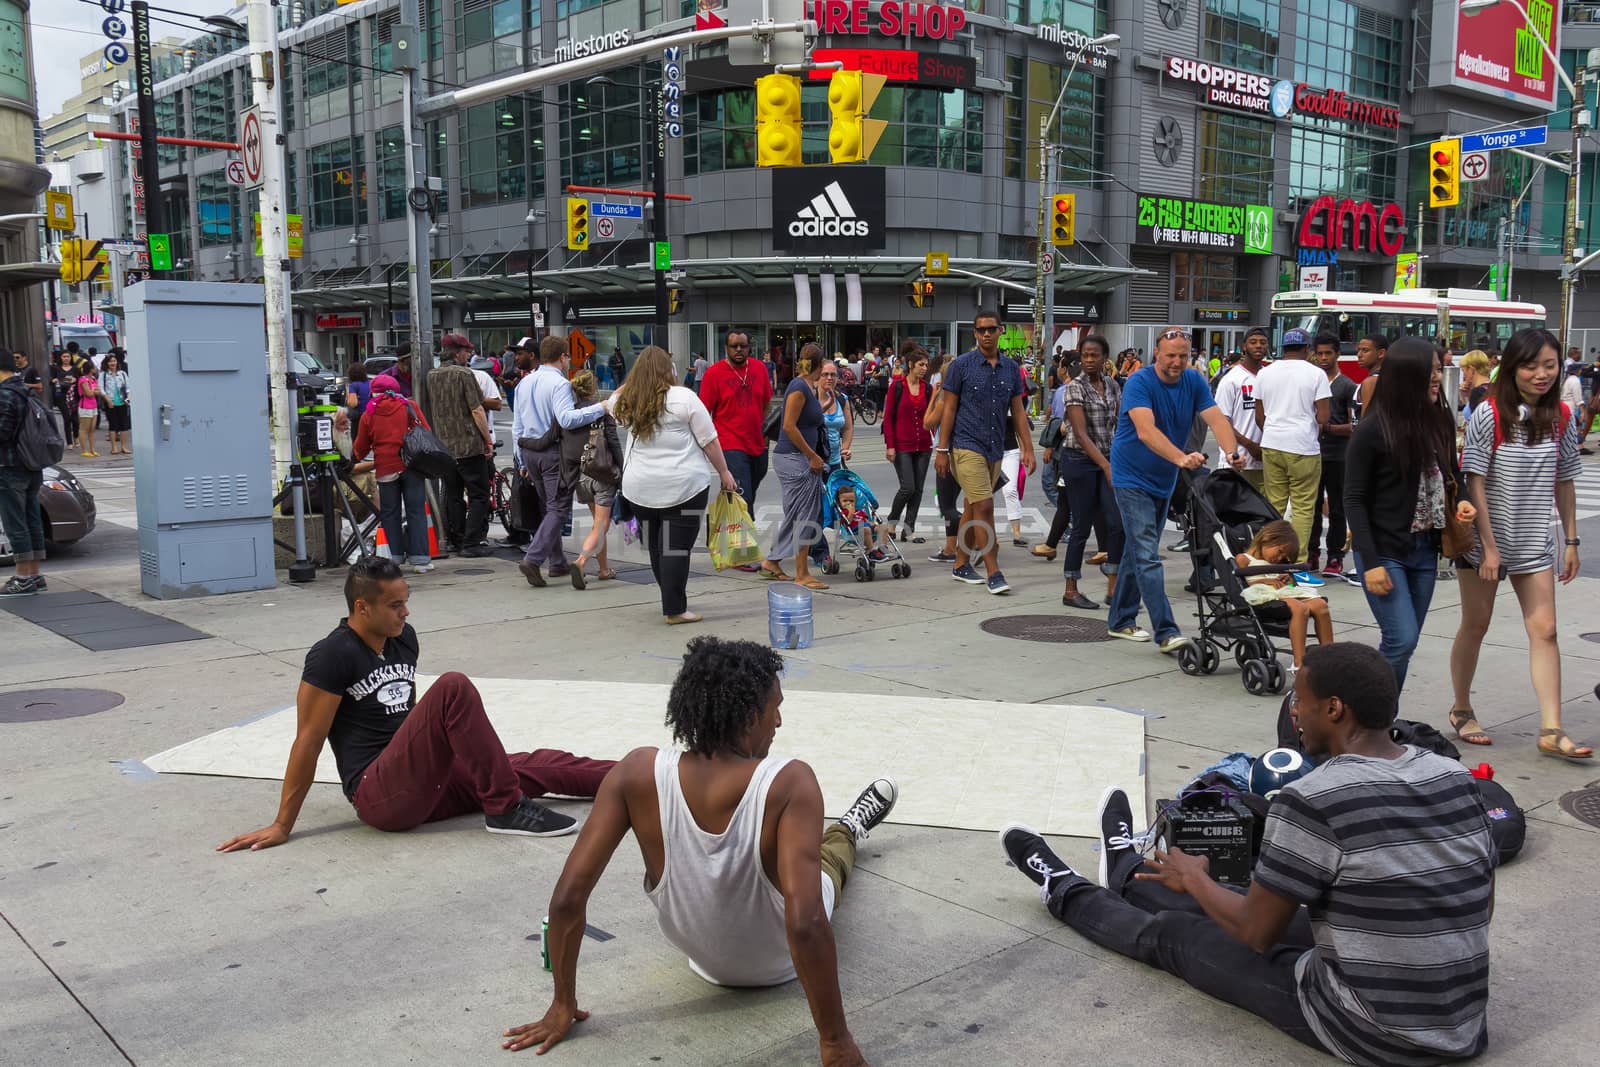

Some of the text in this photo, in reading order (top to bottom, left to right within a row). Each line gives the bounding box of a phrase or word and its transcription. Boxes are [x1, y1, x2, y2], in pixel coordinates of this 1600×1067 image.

[879, 2, 966, 40] SHOP
[138, 10, 152, 96] DOWNTOWN
[554, 28, 629, 63] milestones
[1065, 51, 1108, 70] GRLL BAR
[1517, 32, 1542, 77] WALK
[858, 56, 966, 84] Future Shop
[1167, 57, 1270, 98] SHOPPERS
[1211, 89, 1270, 114] DRUG MART
[1295, 83, 1400, 128] GoodLife FITNESS
[1481, 131, 1527, 149] Yonge St
[601, 205, 628, 217] Dundas
[789, 216, 869, 237] adidas
[1138, 196, 1244, 235] 25 FAB EATERIES!
[1162, 228, 1180, 242] FREE
[1199, 234, 1209, 244] ON
[1211, 235, 1229, 247] LEVEL
[1230, 235, 1235, 247] 3
[1247, 210, 1269, 249] 10
[1203, 826, 1243, 837] CUBE
